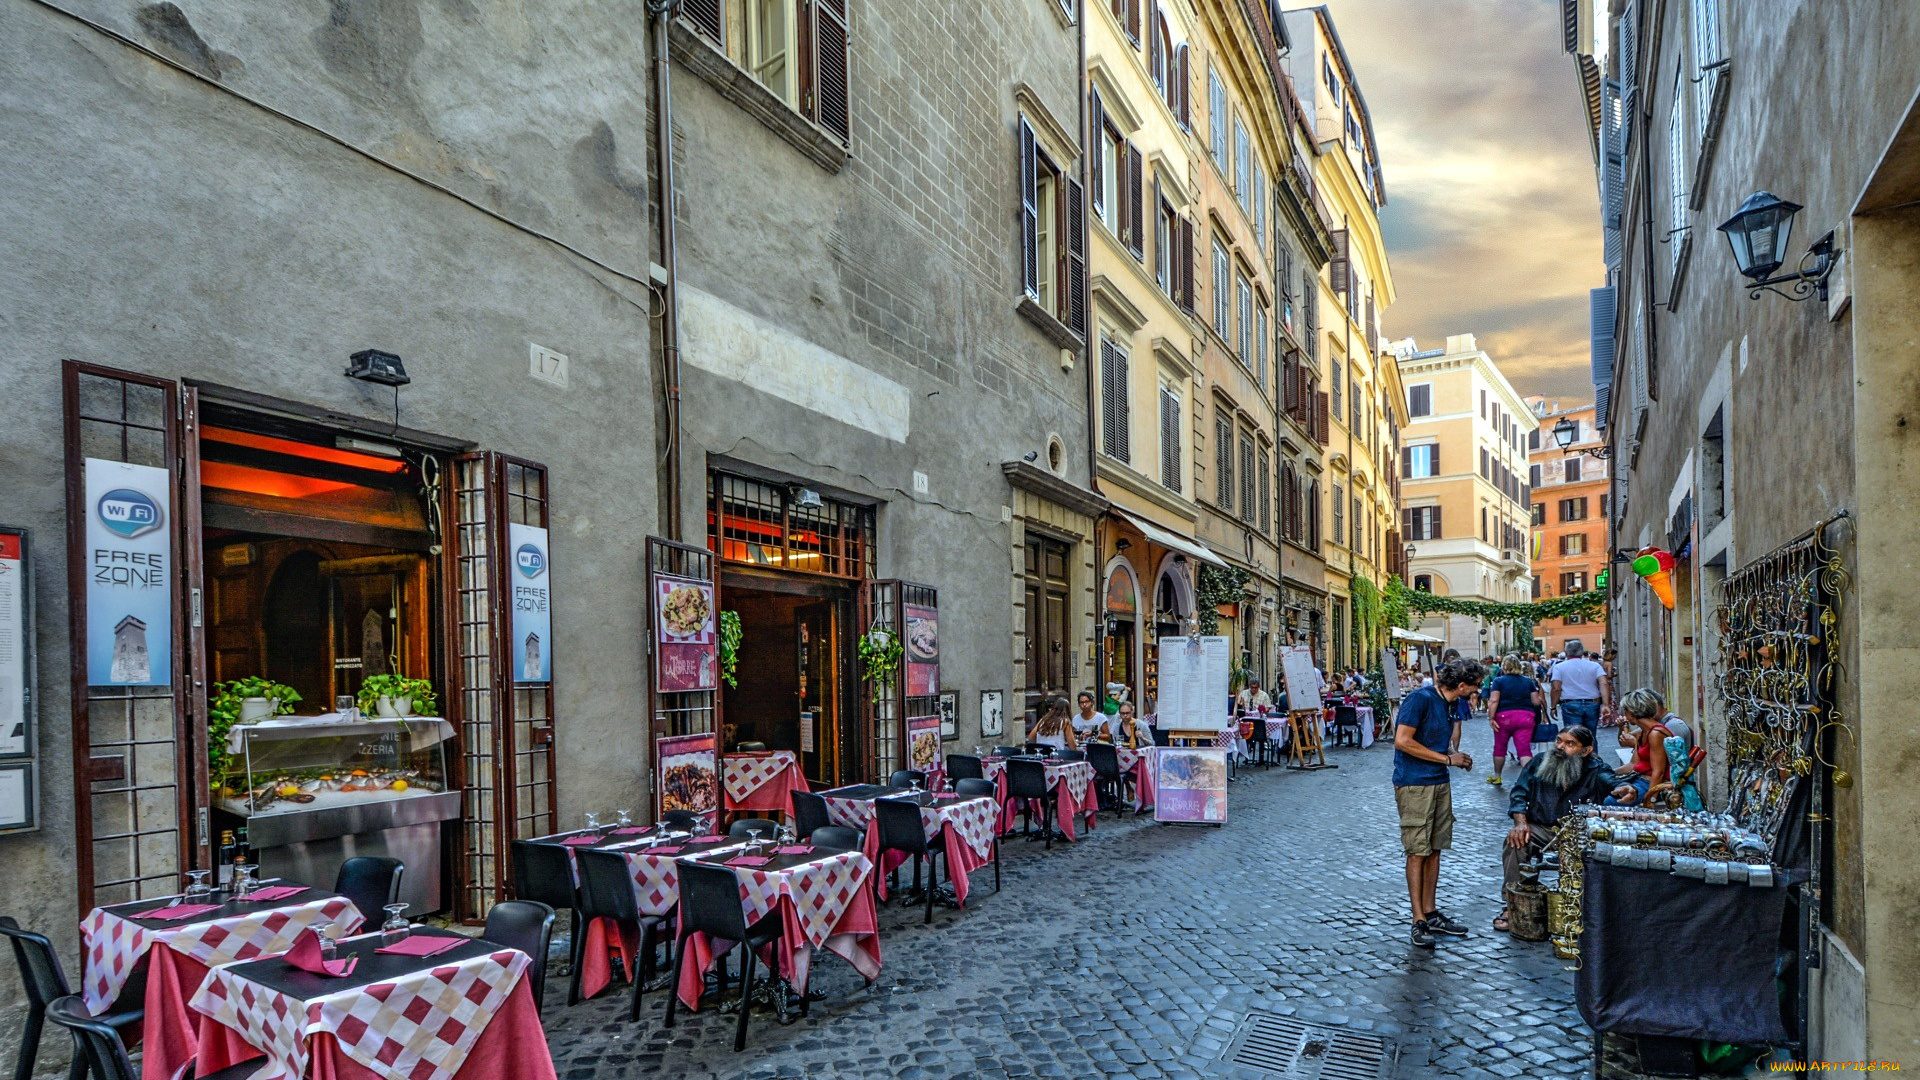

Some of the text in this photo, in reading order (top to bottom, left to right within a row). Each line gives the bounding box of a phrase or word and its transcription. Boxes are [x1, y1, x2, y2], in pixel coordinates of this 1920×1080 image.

[917, 475, 925, 489] 18
[1003, 507, 1010, 519] 19
[95, 549, 163, 569] FREE
[95, 565, 163, 584] ZONE
[516, 586, 547, 600] FREE
[516, 597, 547, 610] ZONE
